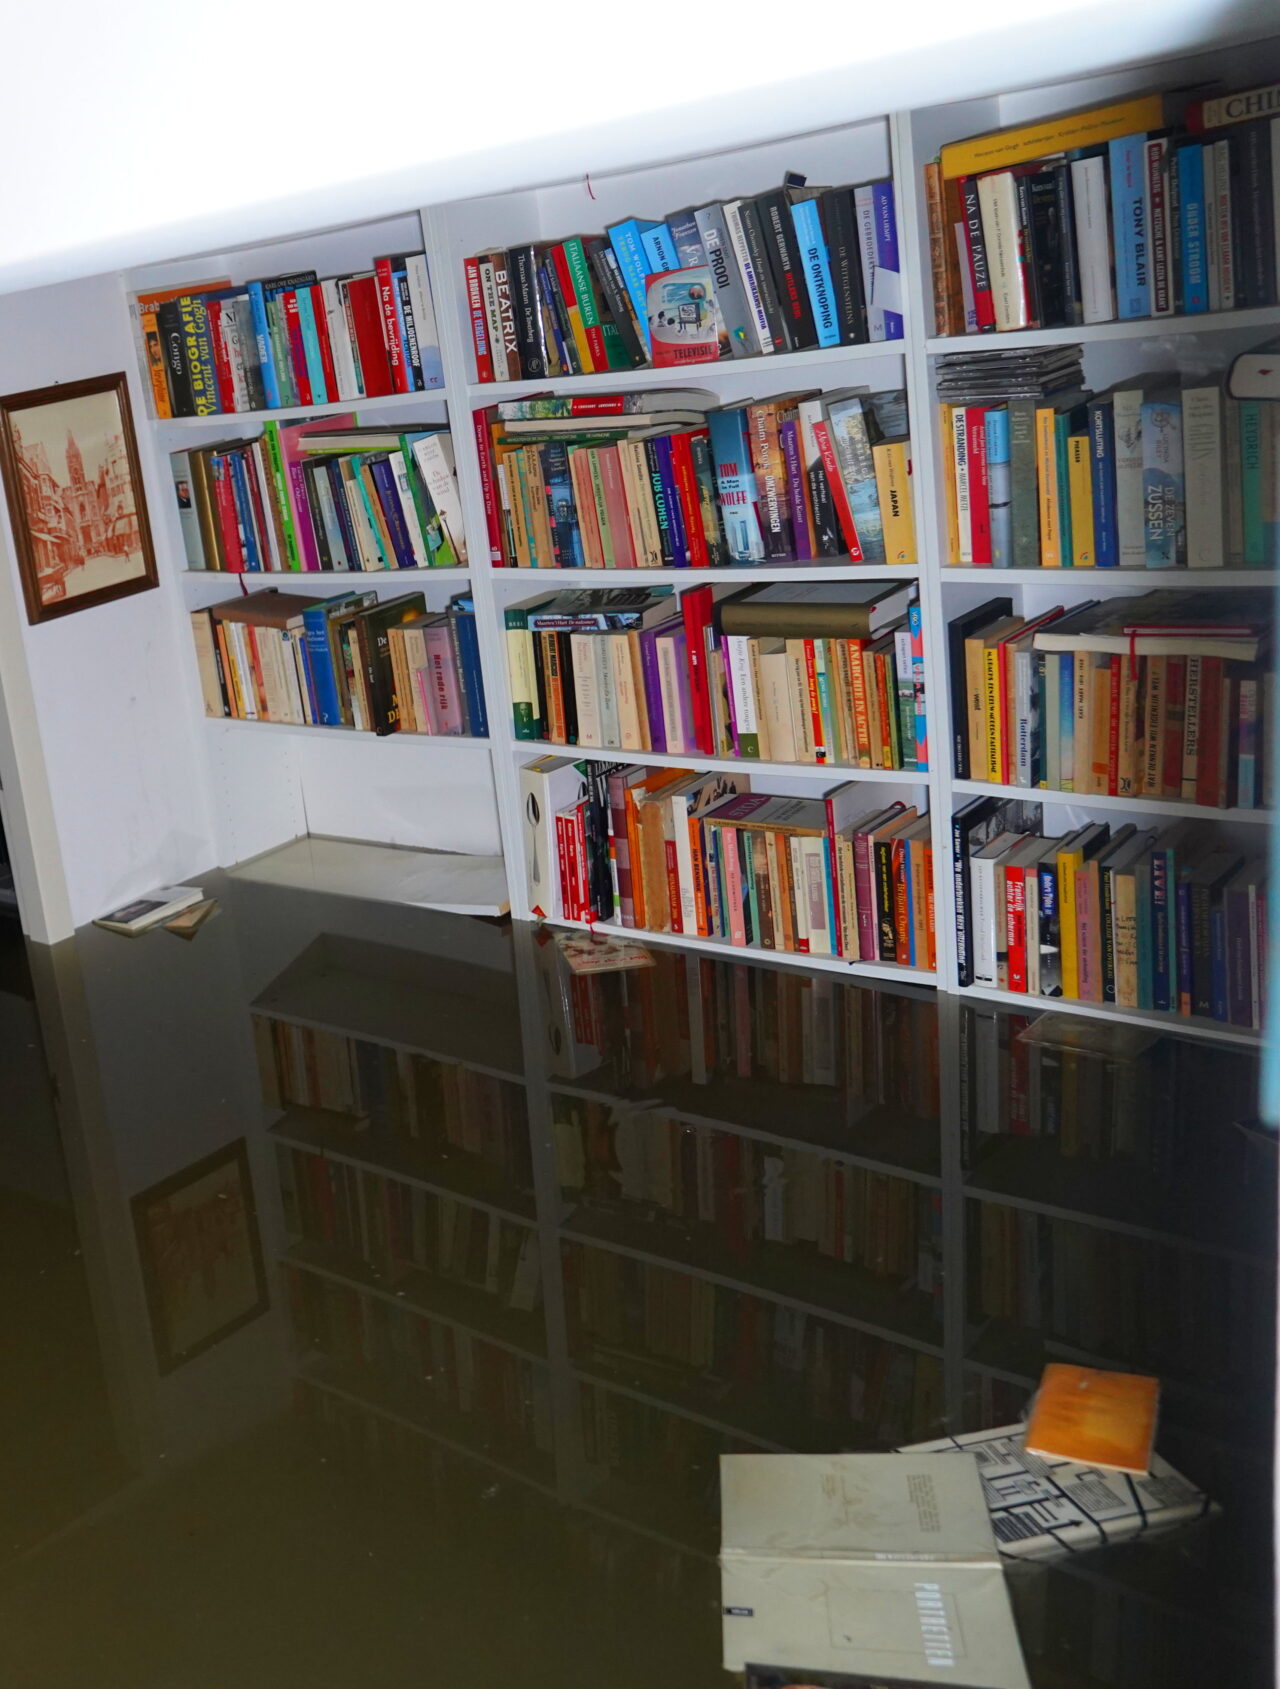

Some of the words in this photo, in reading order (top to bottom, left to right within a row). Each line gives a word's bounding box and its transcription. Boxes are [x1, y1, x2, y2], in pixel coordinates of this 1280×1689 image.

[1151, 147, 1159, 160] ROB
[862, 210, 870, 220] DE
[882, 206, 890, 219] VAN
[964, 194, 975, 214] NA
[769, 206, 782, 235] ROBERT
[968, 219, 979, 238] DE
[1132, 197, 1145, 237] TONY
[1186, 204, 1198, 238] ONDER
[625, 233, 634, 251] TOM
[704, 229, 720, 250] DE
[618, 236, 629, 262] TERUG
[626, 265, 638, 288] NAAR
[652, 236, 666, 259] ARNON
[662, 262, 671, 273] GR
[775, 235, 791, 270] GERWARTH
[808, 247, 818, 262] DE
[838, 247, 847, 258] DE
[1188, 241, 1201, 284] STROOM
[468, 265, 478, 278] JAN
[485, 268, 492, 282] ON
[518, 255, 528, 283] Thomas
[710, 250, 731, 289] PROOI
[743, 263, 751, 271] DE
[972, 245, 987, 288] PAUZE
[1134, 243, 1147, 287] BLAIR
[382, 287, 391, 301] Na
[469, 279, 481, 308] BROKKEN
[486, 284, 496, 306] THE
[522, 284, 530, 304] Mann
[569, 242, 588, 291] ITALIAANSE
[580, 294, 595, 325] BUREN
[593, 339, 601, 356] PARKS
[811, 264, 832, 328] ONTKNOPING
[191, 299, 207, 333] Gogh
[385, 304, 393, 316] de
[403, 305, 412, 314] DE
[473, 310, 480, 318] DE
[490, 309, 500, 332] MAP
[495, 270, 517, 353] BEATRIX
[180, 297, 201, 391] BIOGRAFIE
[198, 337, 210, 360] van
[256, 334, 268, 363] VADER
[387, 318, 400, 366] bevrijding
[405, 316, 420, 367] MILJOENENROOF
[474, 319, 487, 355] VERGELDING
[170, 332, 183, 374] Congo
[673, 345, 713, 359] TELEVISIE
[202, 365, 217, 414] Vincent
[195, 396, 208, 416] DE
[755, 410, 770, 441] Chaim
[955, 414, 963, 423] DE
[476, 425, 484, 443] Down
[786, 431, 797, 456] Maarten
[956, 424, 967, 466] STRANDING
[1094, 410, 1105, 459] KORTSLUITING
[1244, 413, 1260, 471] HEYDRICH
[480, 452, 489, 469] Earth
[761, 442, 773, 469] Potok
[1074, 440, 1082, 463] PICASSO
[719, 463, 738, 477] TOM
[790, 461, 798, 475] Hart
[817, 471, 825, 482] Het
[483, 483, 491, 492] Up
[651, 473, 662, 492] JOB
[818, 483, 828, 504] verhaal
[959, 473, 968, 493] MARCEL
[1164, 487, 1176, 502] DE
[719, 490, 747, 506] WOLFE
[765, 475, 781, 533] OMZWERVINGEN
[811, 491, 822, 526] architectuur
[889, 490, 901, 517] JAPAN
[654, 493, 669, 529] COHEN
[795, 506, 804, 524] Kunst
[1147, 484, 1164, 541] ZUSSEN
[1166, 504, 1177, 537] ZEVEN
[434, 654, 444, 670] Het
[849, 643, 864, 699] ANARCHIE
[436, 671, 446, 693] rode
[438, 694, 448, 710] rijk
[855, 701, 863, 712] IN
[1185, 657, 1199, 756] HERSTELLERS
[856, 714, 869, 745] ACTIE
[1019, 718, 1029, 767] Rotterdam
[692, 848, 701, 862] HAN
[898, 848, 907, 864] David
[693, 863, 703, 892] BENNINK
[1153, 858, 1166, 905] LIVE!
[1006, 880, 1015, 902] achter
[1014, 881, 1026, 911] Frankrijk
[1007, 903, 1015, 912] de
[1007, 913, 1017, 945] schermen
[913, 1582, 957, 1668] PORTRETTEN
